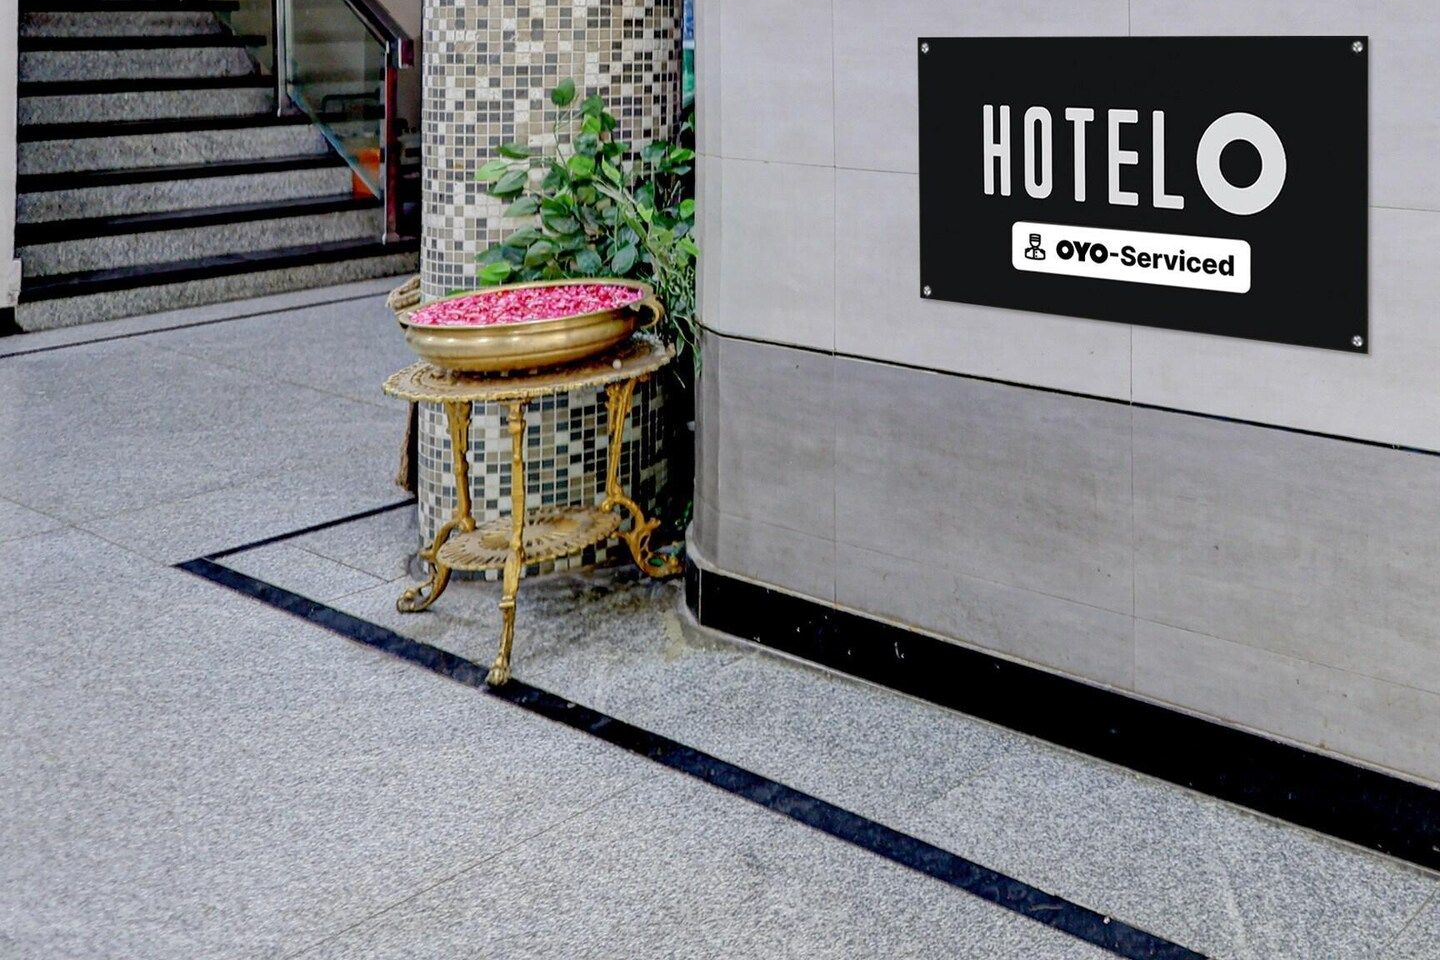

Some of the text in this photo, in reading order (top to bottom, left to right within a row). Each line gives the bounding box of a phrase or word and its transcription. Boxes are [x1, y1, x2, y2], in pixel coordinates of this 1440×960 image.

[983, 104, 1287, 215] HOTEL O
[1056, 239, 1235, 277] OYO-Serviced
